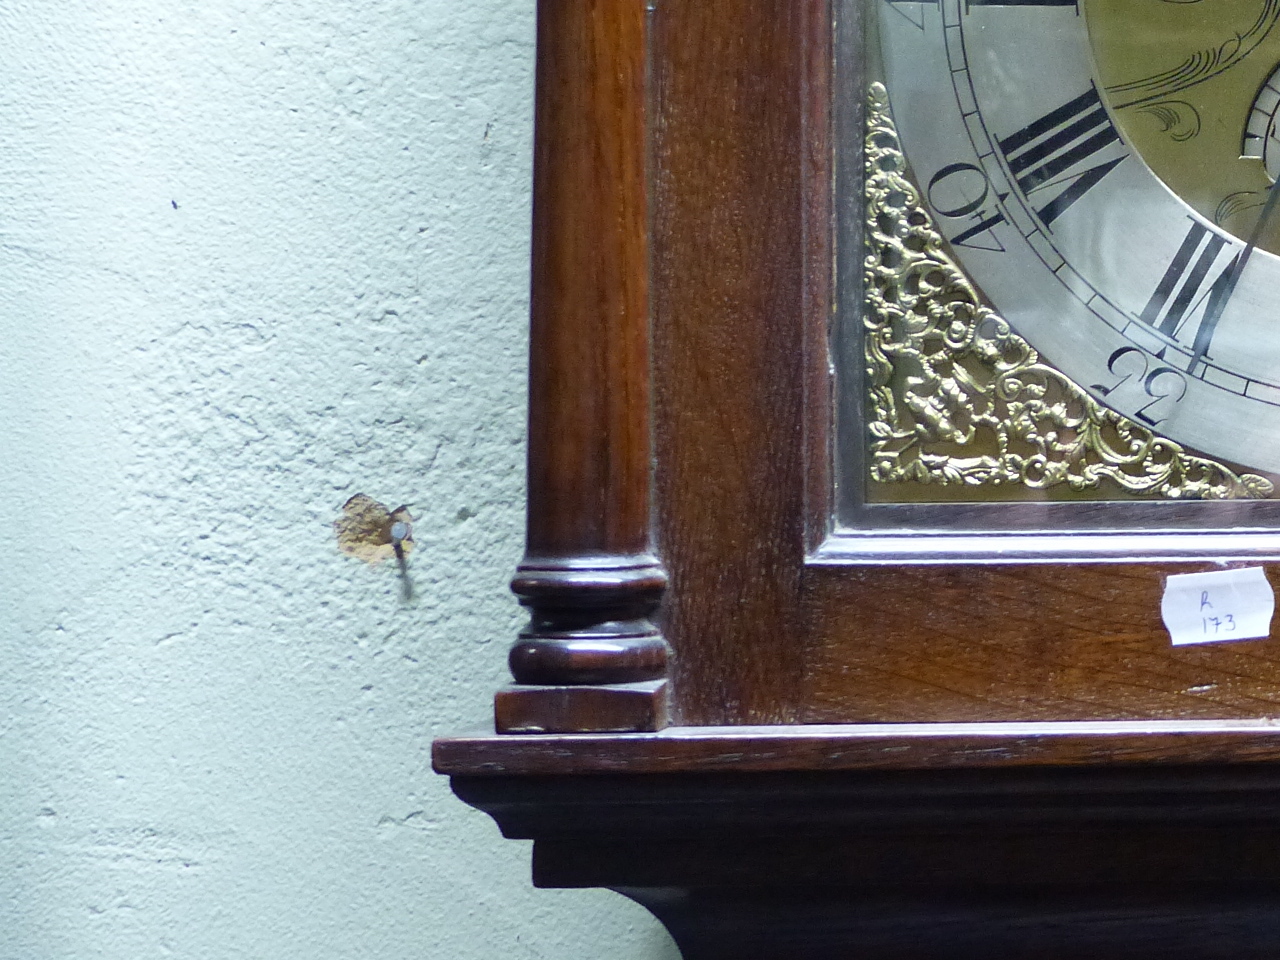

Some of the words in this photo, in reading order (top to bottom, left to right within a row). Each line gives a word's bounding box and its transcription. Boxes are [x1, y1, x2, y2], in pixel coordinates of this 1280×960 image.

[926, 162, 1012, 253] 40
[1089, 345, 1189, 427] 35
[1202, 614, 1237, 634] 173
